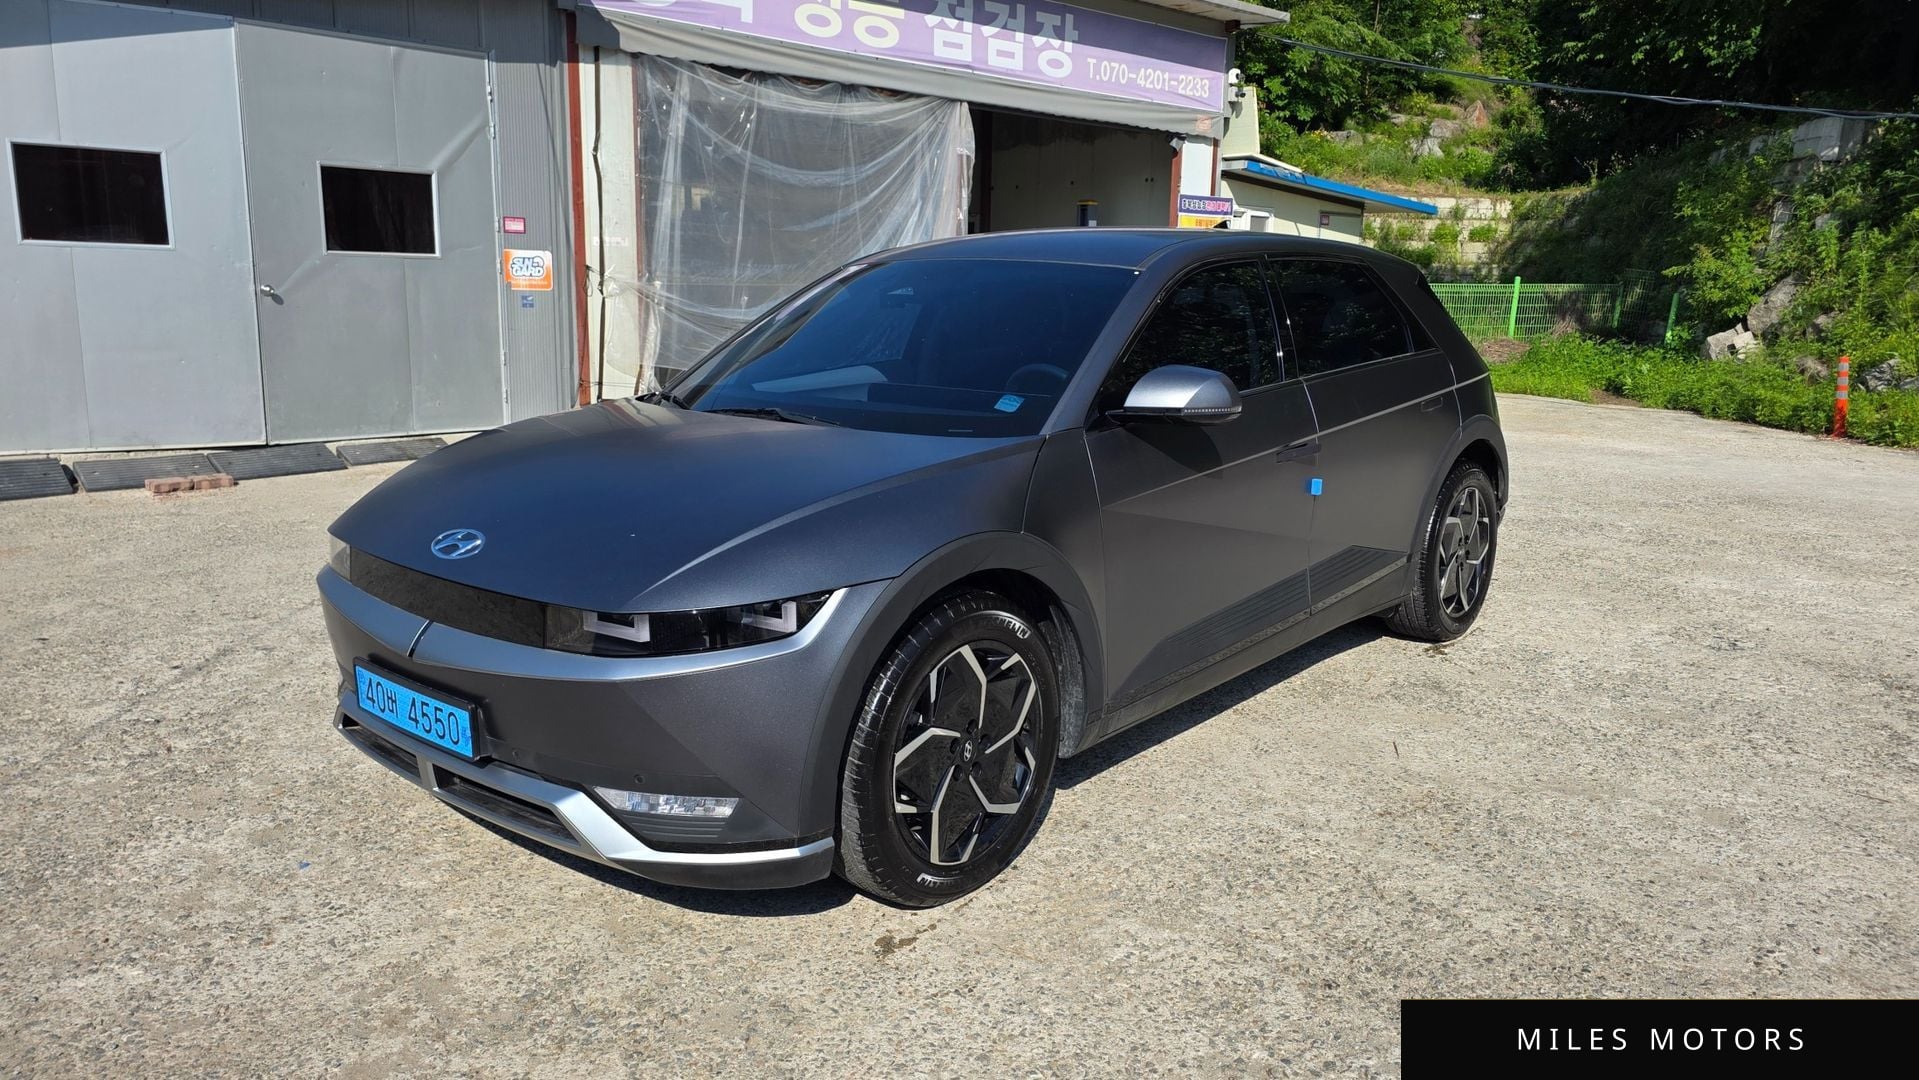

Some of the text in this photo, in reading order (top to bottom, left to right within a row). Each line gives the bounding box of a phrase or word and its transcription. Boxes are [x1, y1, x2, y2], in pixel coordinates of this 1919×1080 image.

[924, 0, 1078, 78] 점검장
[1087, 58, 1210, 98] T.070-4201-2233
[366, 677, 398, 718] 40버
[408, 697, 460, 745] 4550
